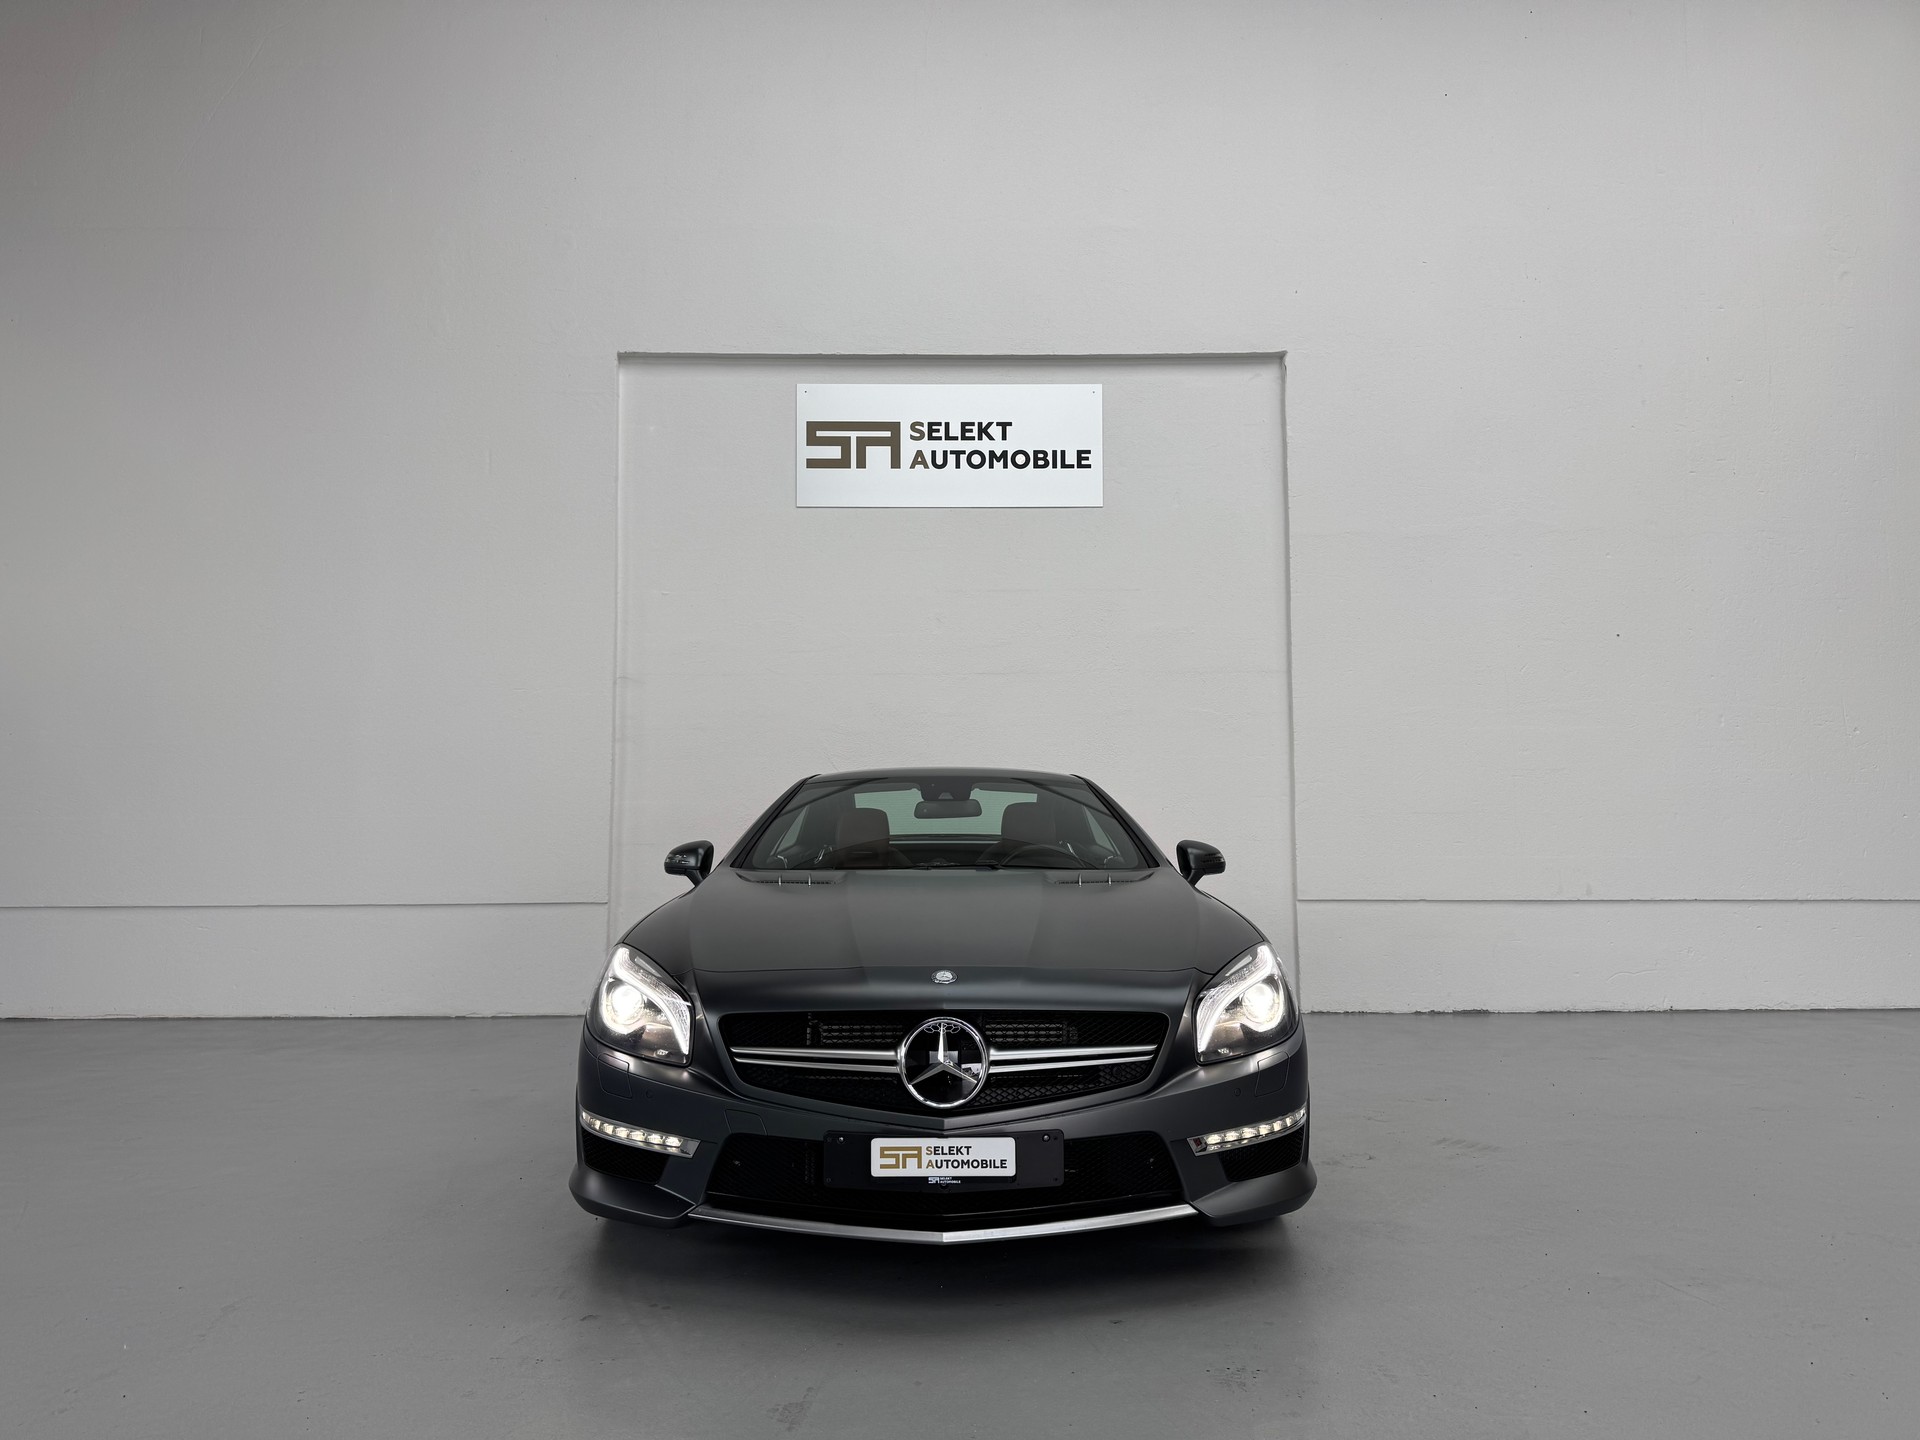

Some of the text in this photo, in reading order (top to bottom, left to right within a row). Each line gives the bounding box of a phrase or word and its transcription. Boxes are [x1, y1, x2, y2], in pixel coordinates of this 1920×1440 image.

[909, 421, 1013, 441] SELEKT
[909, 449, 1092, 470] AUTOMOBILE
[925, 1145, 972, 1156] SELEKT
[925, 1159, 1008, 1169] AUTOMOBILE
